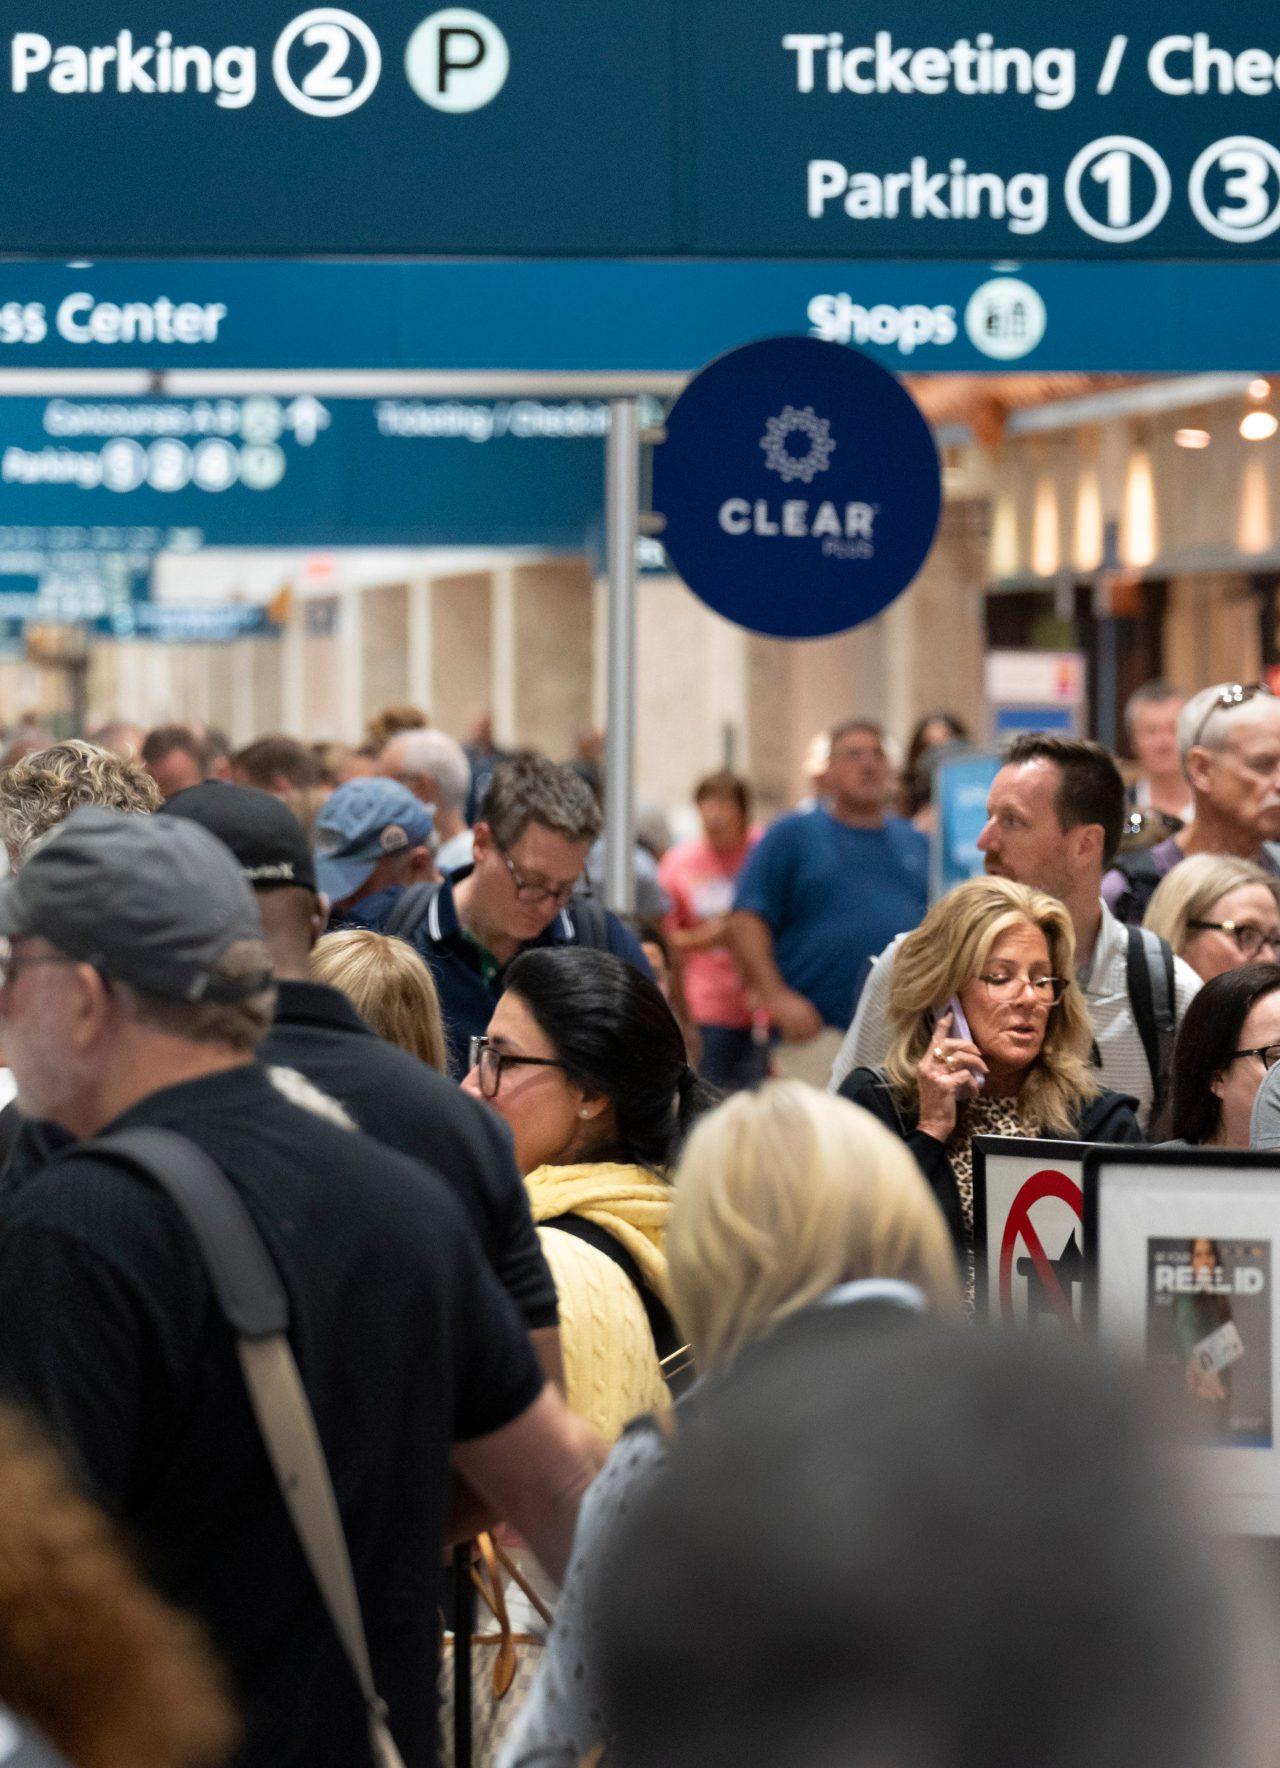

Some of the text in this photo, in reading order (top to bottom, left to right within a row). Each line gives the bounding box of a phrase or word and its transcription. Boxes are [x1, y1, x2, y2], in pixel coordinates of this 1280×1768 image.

[10, 29, 258, 109] Parking
[782, 30, 1077, 110] Ticketing
[1096, 34, 1128, 95] /
[807, 156, 1049, 235] Parking
[56, 291, 227, 344] Center
[807, 292, 958, 356] Shops
[718, 497, 875, 540] CLEAR
[1154, 1264, 1265, 1295] REAL ID
